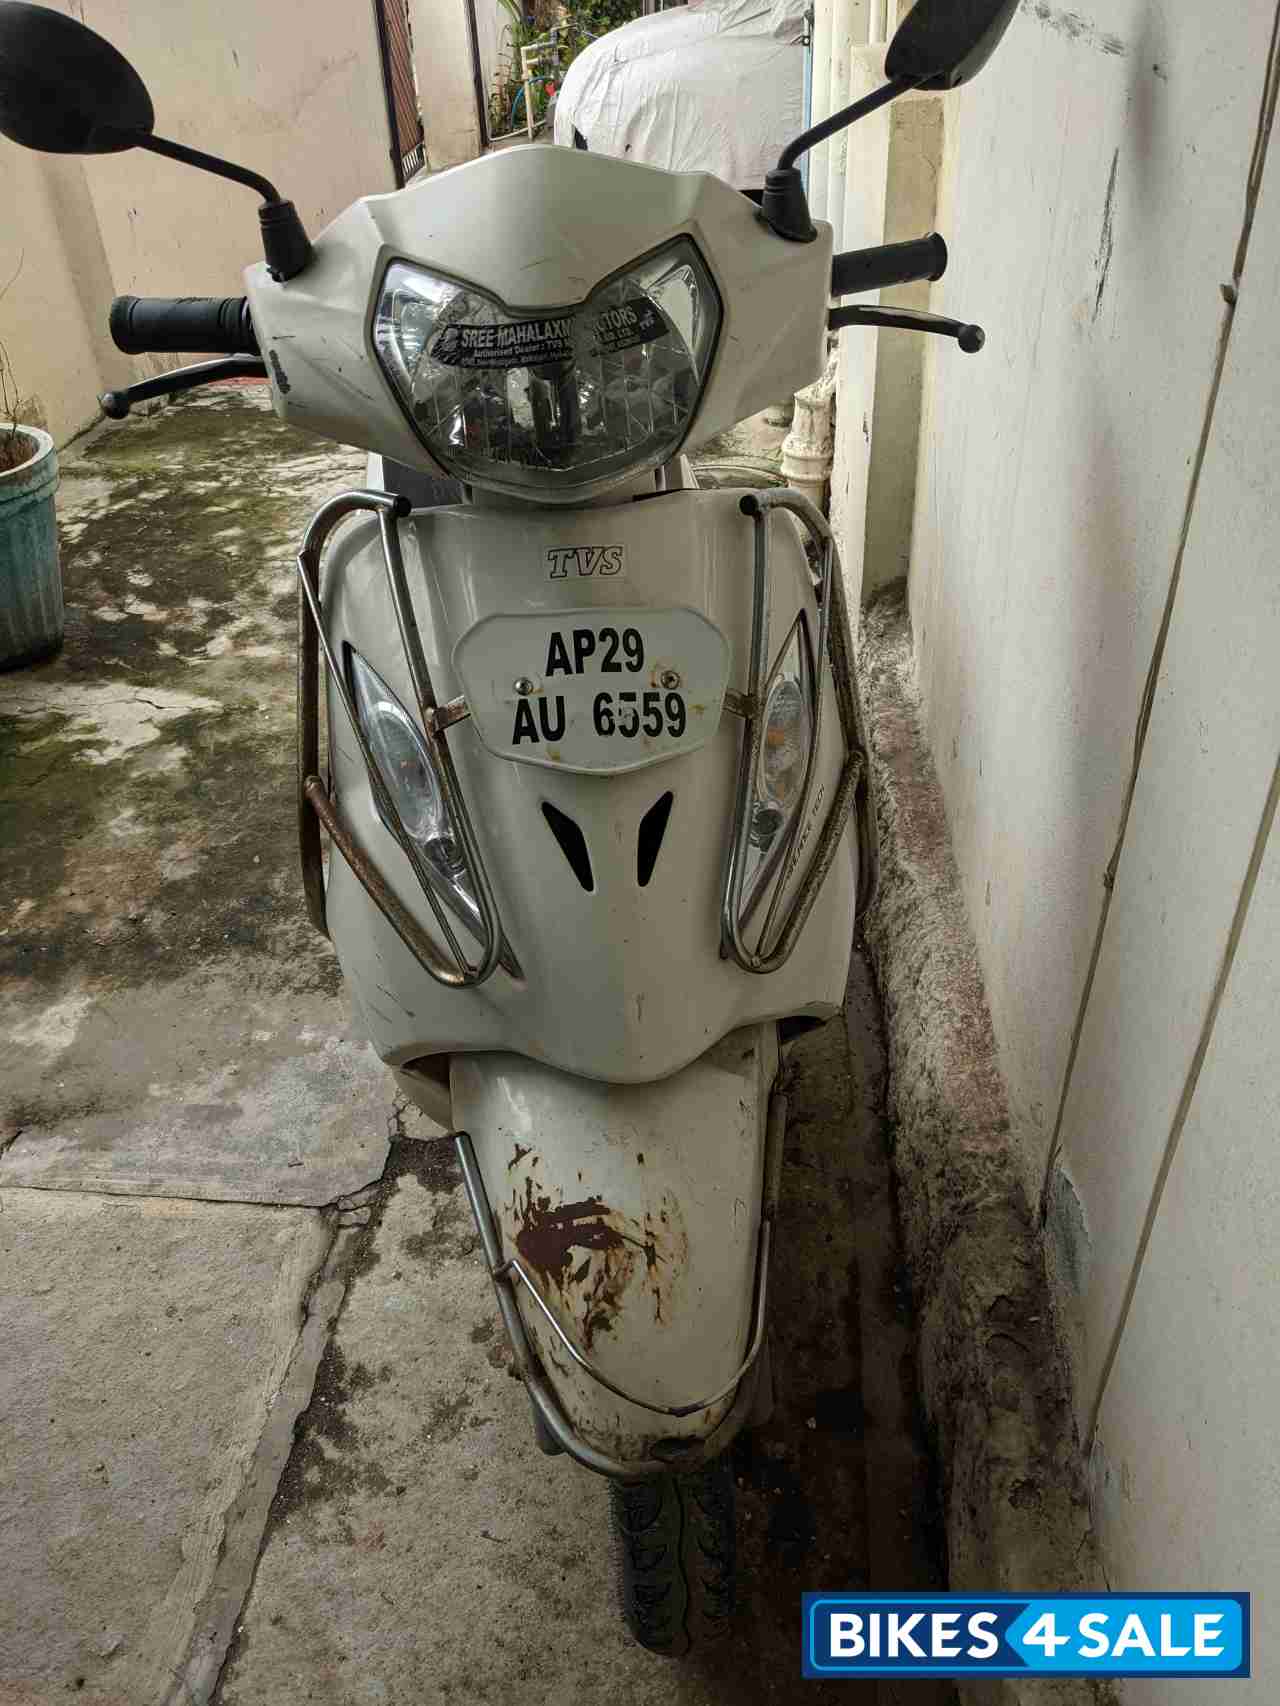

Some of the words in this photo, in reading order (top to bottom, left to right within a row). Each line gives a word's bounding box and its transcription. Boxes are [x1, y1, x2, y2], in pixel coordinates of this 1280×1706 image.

[462, 328, 494, 348] SREE
[496, 317, 575, 346] MAHALAXM
[547, 546, 623, 578] TVS
[545, 628, 645, 676] AP29
[512, 695, 566, 745] AU
[593, 691, 687, 738] 6559
